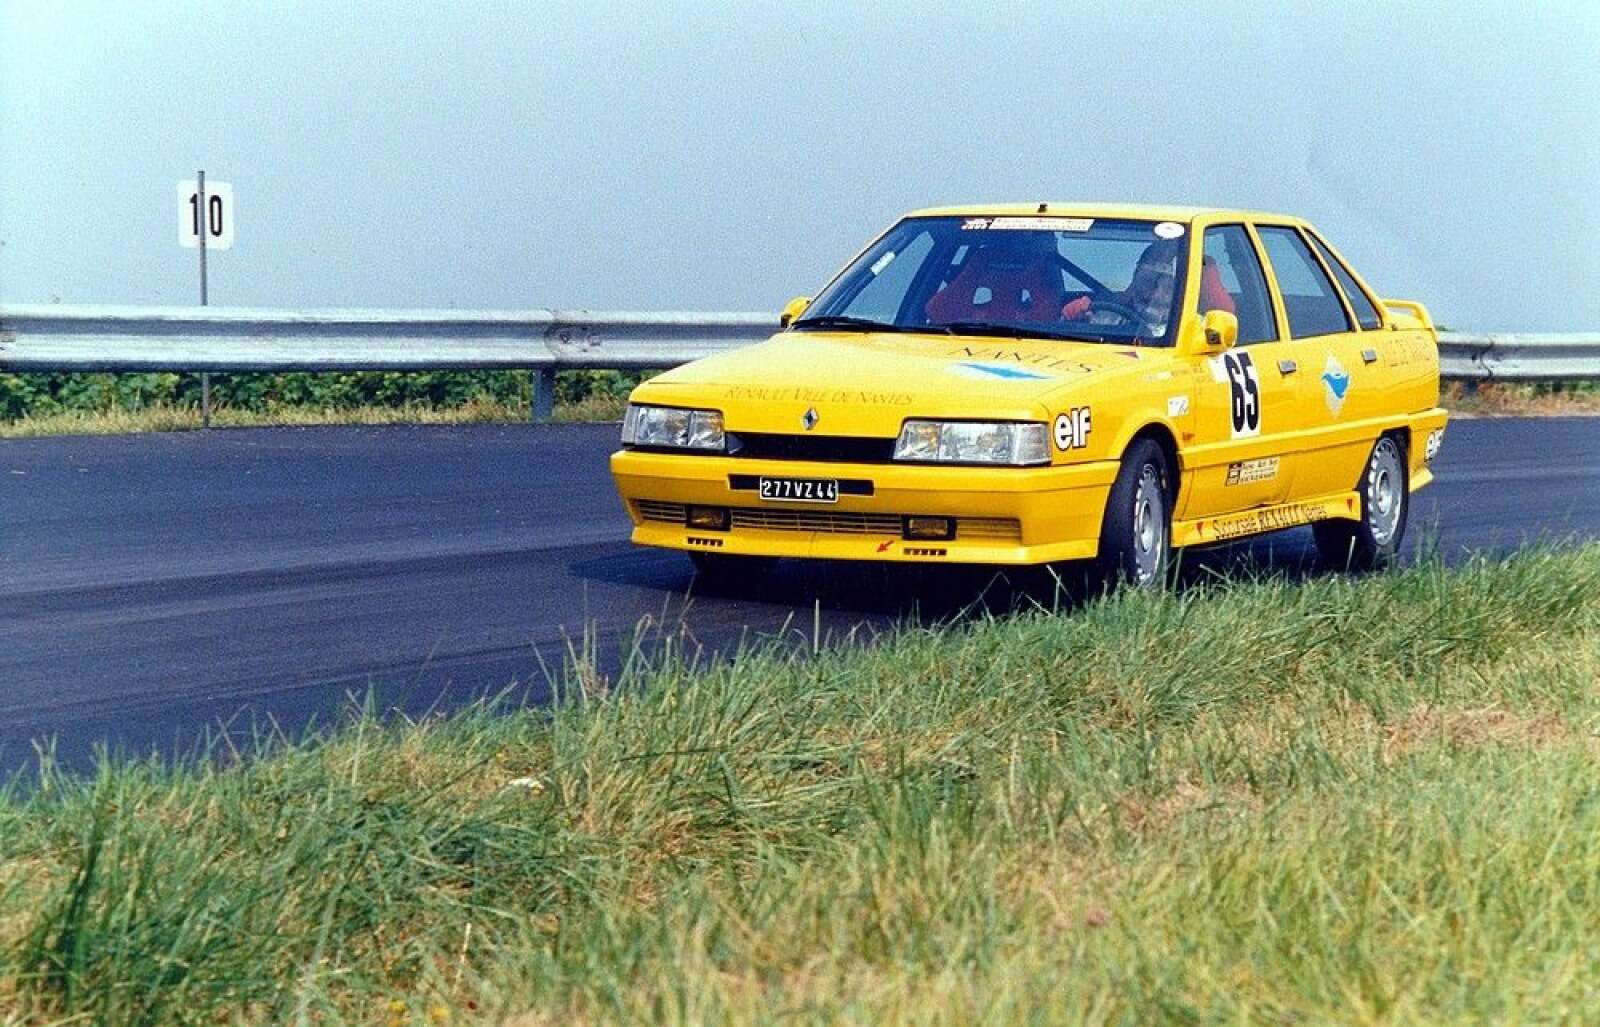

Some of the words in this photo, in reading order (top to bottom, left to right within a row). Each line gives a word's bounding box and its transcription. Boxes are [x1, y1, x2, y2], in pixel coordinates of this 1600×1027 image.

[189, 193, 222, 237] 10
[1224, 352, 1259, 433] 65
[1053, 405, 1092, 452] elf
[762, 480, 835, 499] 277VZ44
